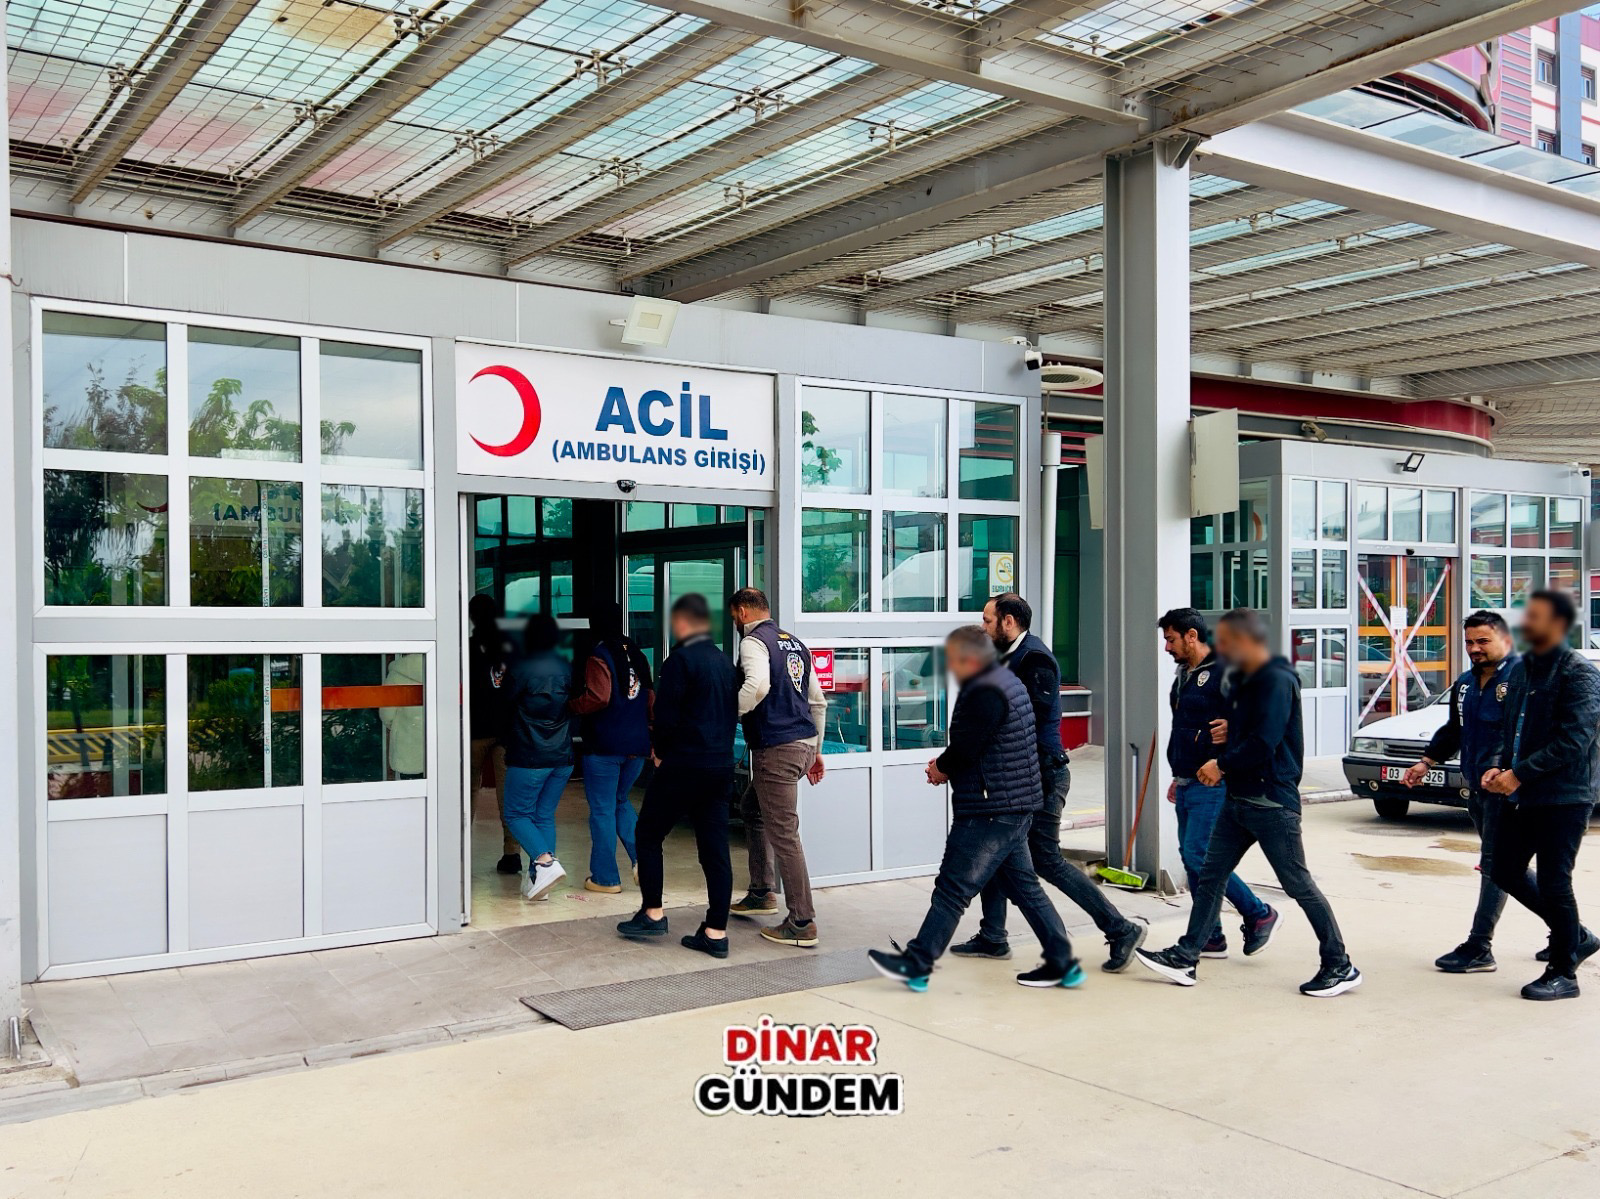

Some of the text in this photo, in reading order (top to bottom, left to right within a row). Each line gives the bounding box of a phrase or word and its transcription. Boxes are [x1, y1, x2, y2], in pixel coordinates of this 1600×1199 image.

[595, 381, 728, 441] ACİL
[552, 439, 766, 475] (AMBULANS GİRİŞİ)
[1389, 768, 1444, 783] 03 926
